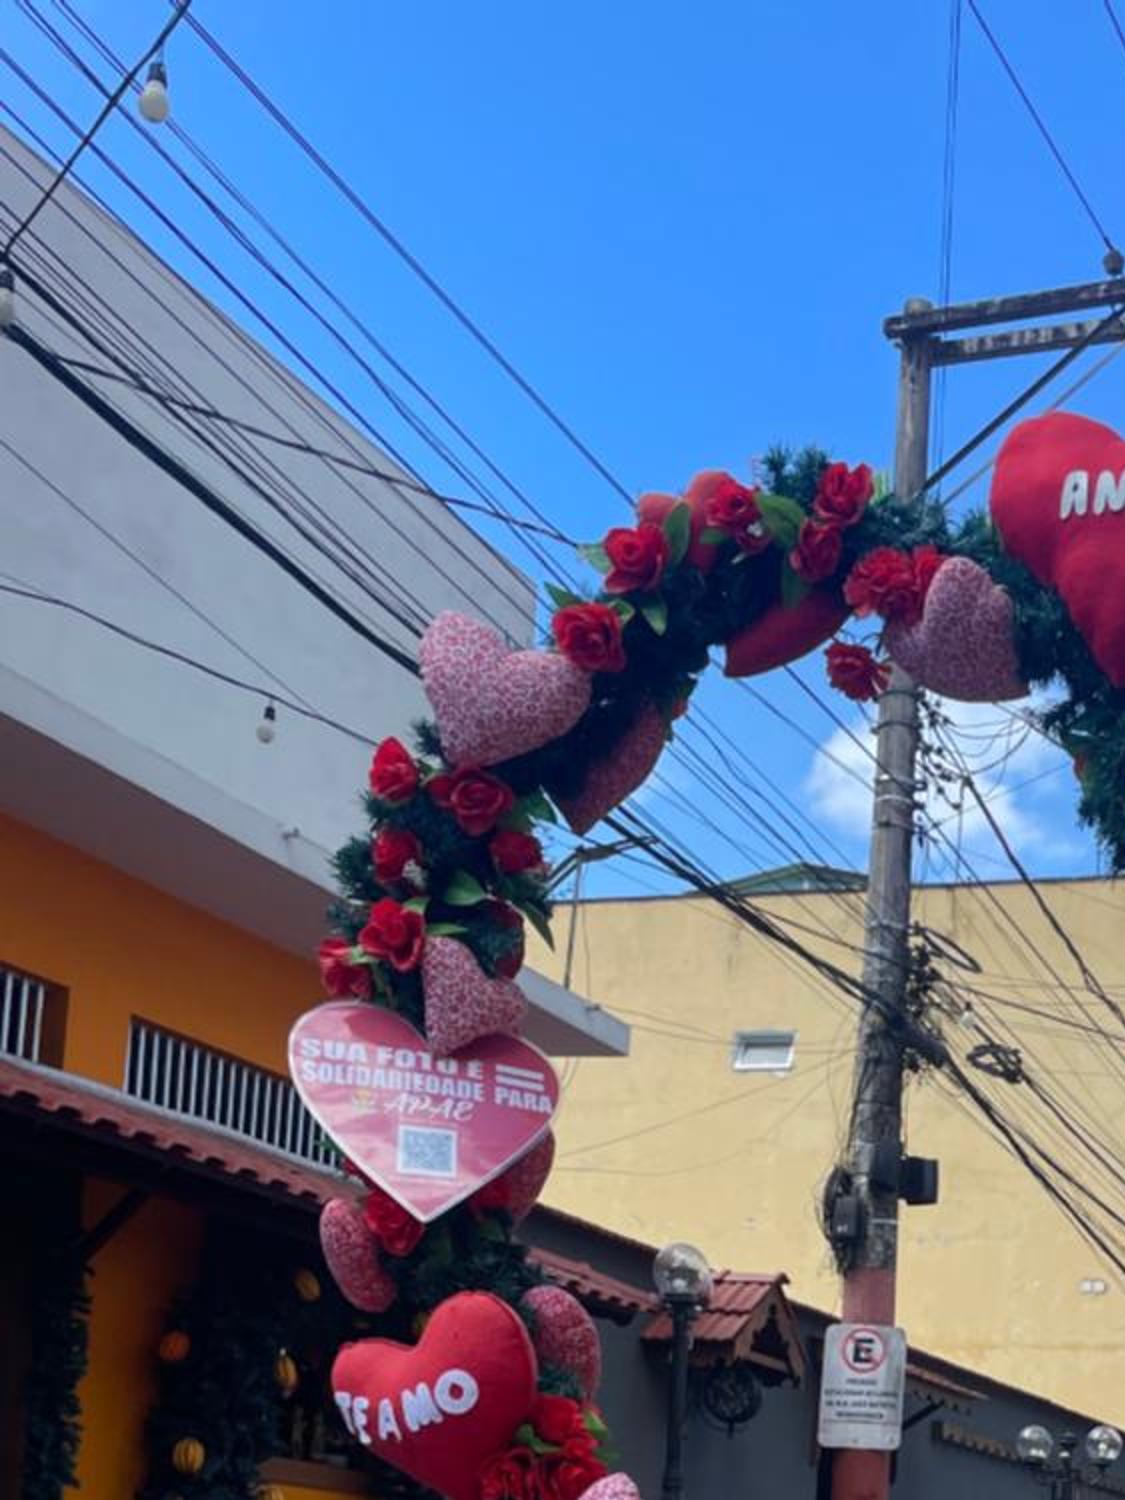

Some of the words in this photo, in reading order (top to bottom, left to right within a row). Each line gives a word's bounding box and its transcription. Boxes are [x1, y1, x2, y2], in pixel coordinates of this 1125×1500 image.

[301, 1037, 367, 1062] SUA
[375, 1046, 459, 1077] FOTO
[301, 1059, 485, 1101] SOLIDARIEDADE
[495, 1086, 552, 1114] PARA
[383, 1092, 475, 1121] APAE
[852, 1338, 875, 1363] E
[334, 1391, 372, 1445] TE
[377, 1368, 480, 1441] AMO
